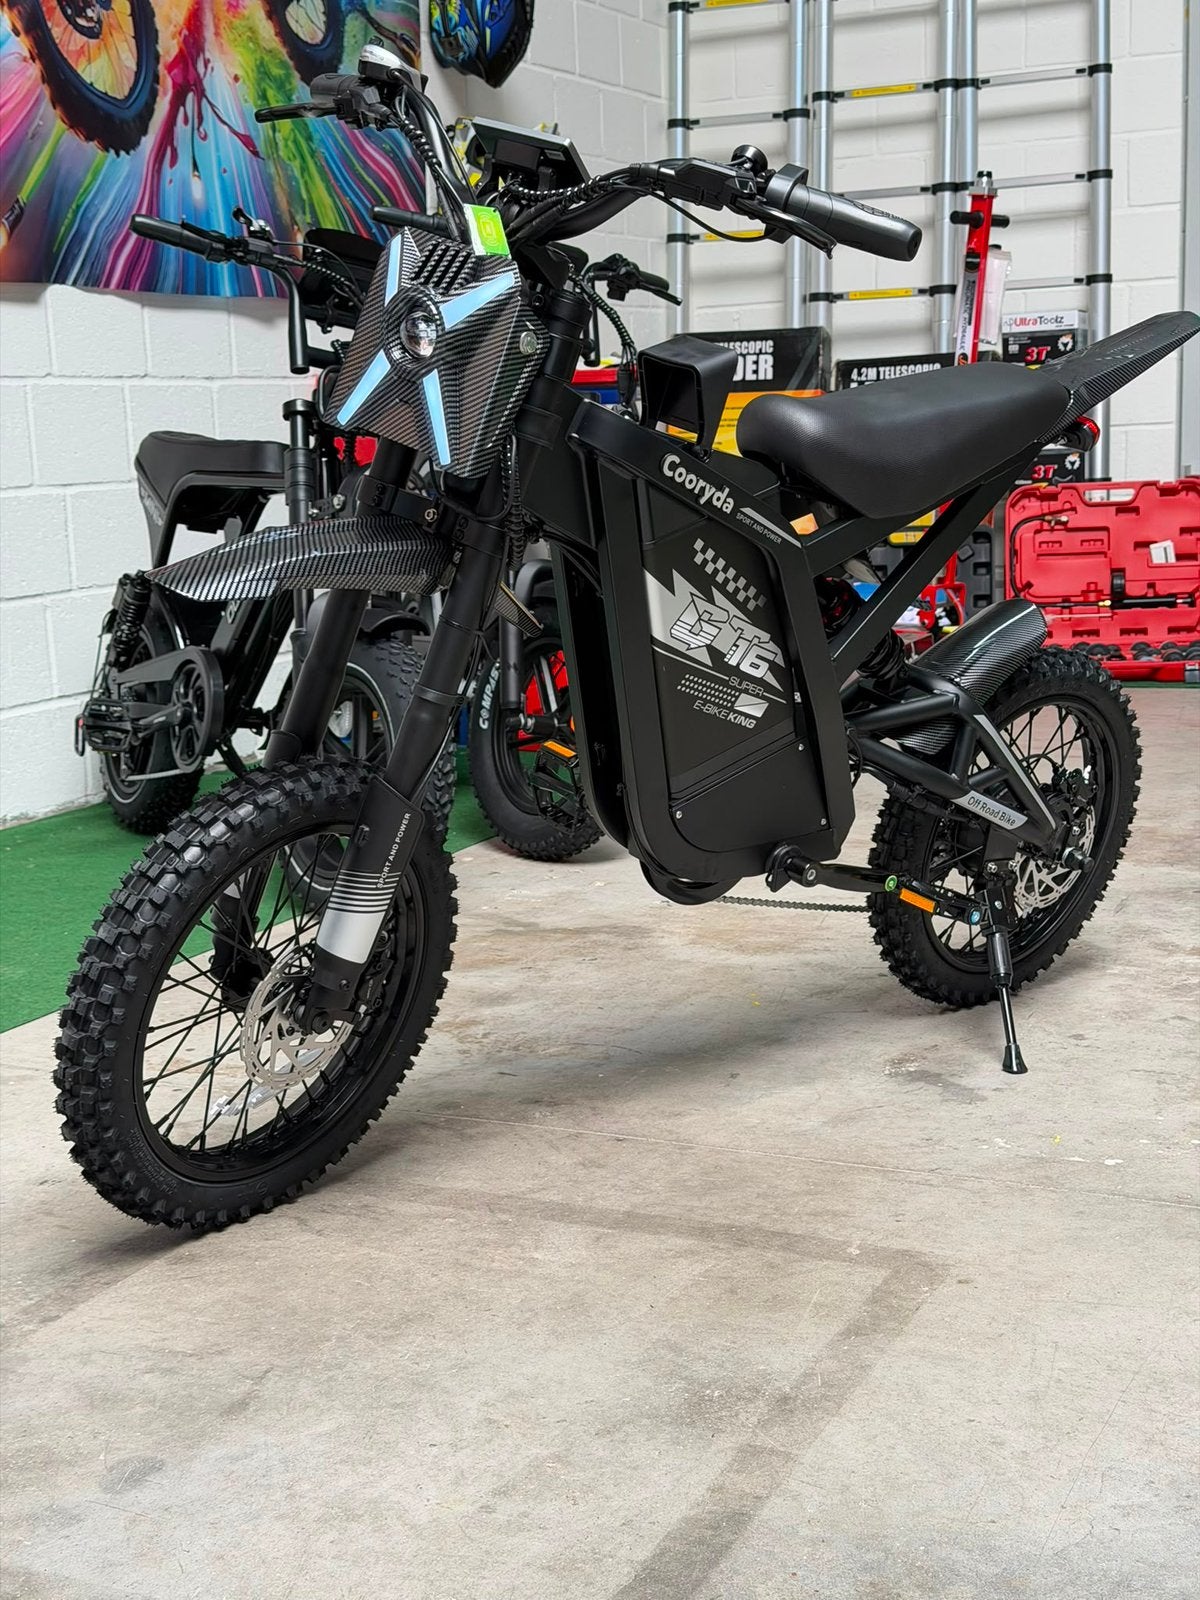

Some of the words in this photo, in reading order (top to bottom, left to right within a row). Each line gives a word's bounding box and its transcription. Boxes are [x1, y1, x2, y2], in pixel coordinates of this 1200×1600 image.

[732, 354, 774, 381] DER
[1024, 346, 1051, 362] 3T
[851, 367, 878, 381] 4.2M
[662, 454, 734, 514] Cooryda
[1031, 464, 1058, 480] 3T
[736, 512, 753, 527] SPORT
[752, 522, 764, 534] AND
[763, 528, 782, 544] POWER
[729, 676, 764, 696] SUPER
[693, 699, 730, 719] E-BIKE
[727, 712, 757, 729] KING
[967, 796, 982, 808] Off
[980, 801, 1000, 819] Road
[999, 810, 1016, 826] Bike
[377, 861, 392, 888] SPORT
[388, 843, 399, 861] AND
[395, 812, 411, 843] POWER
